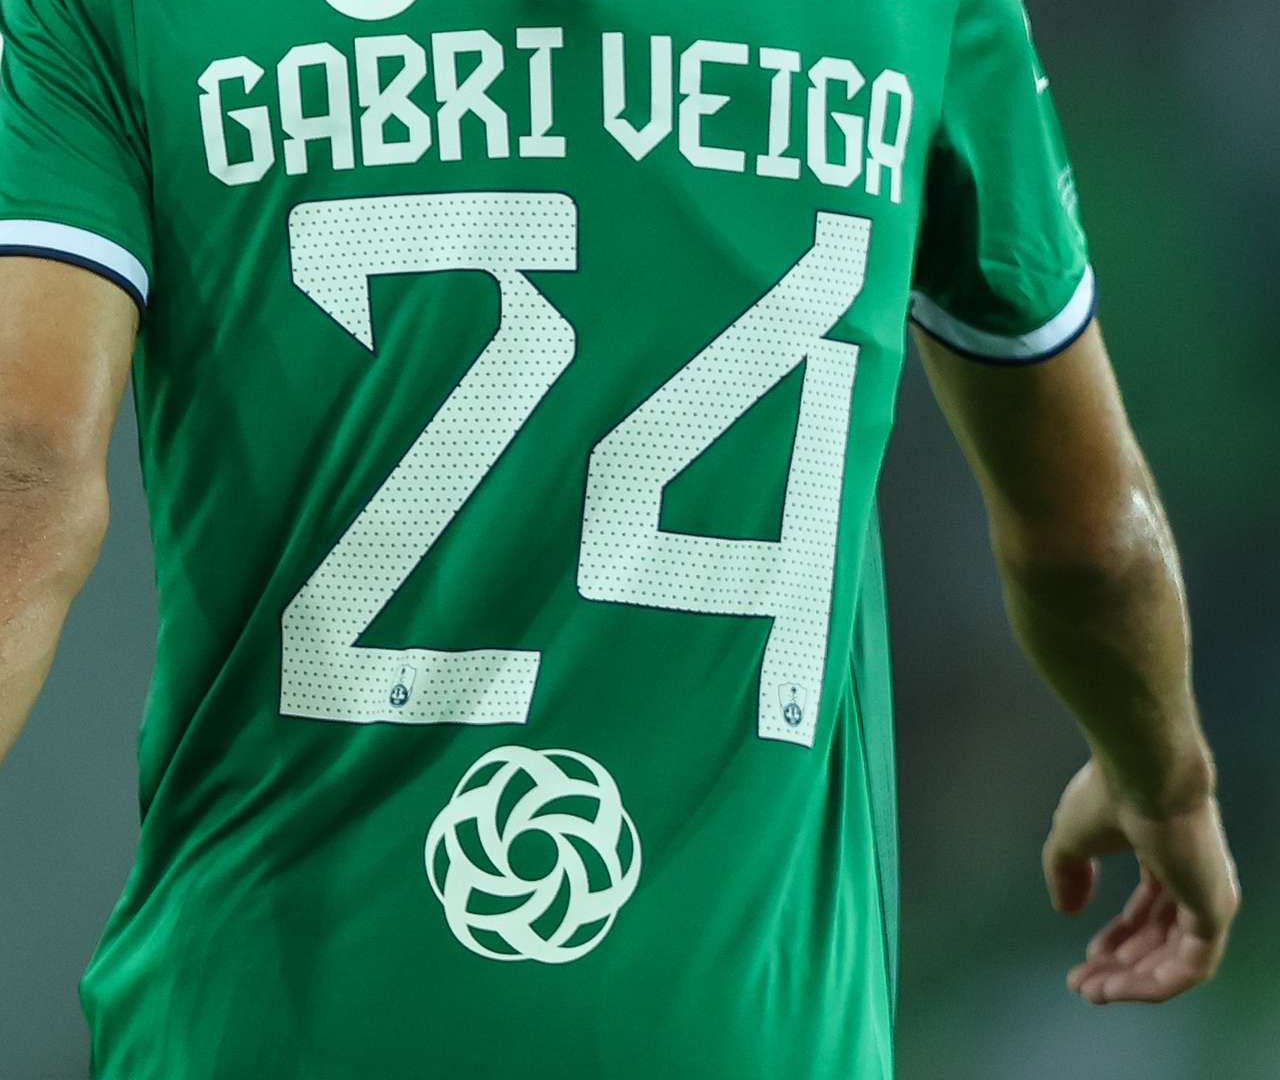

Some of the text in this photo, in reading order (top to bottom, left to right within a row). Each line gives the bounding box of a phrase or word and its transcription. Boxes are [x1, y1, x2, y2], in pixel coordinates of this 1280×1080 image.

[197, 27, 914, 204] GABRI VEIGA
[279, 190, 872, 749] 24
